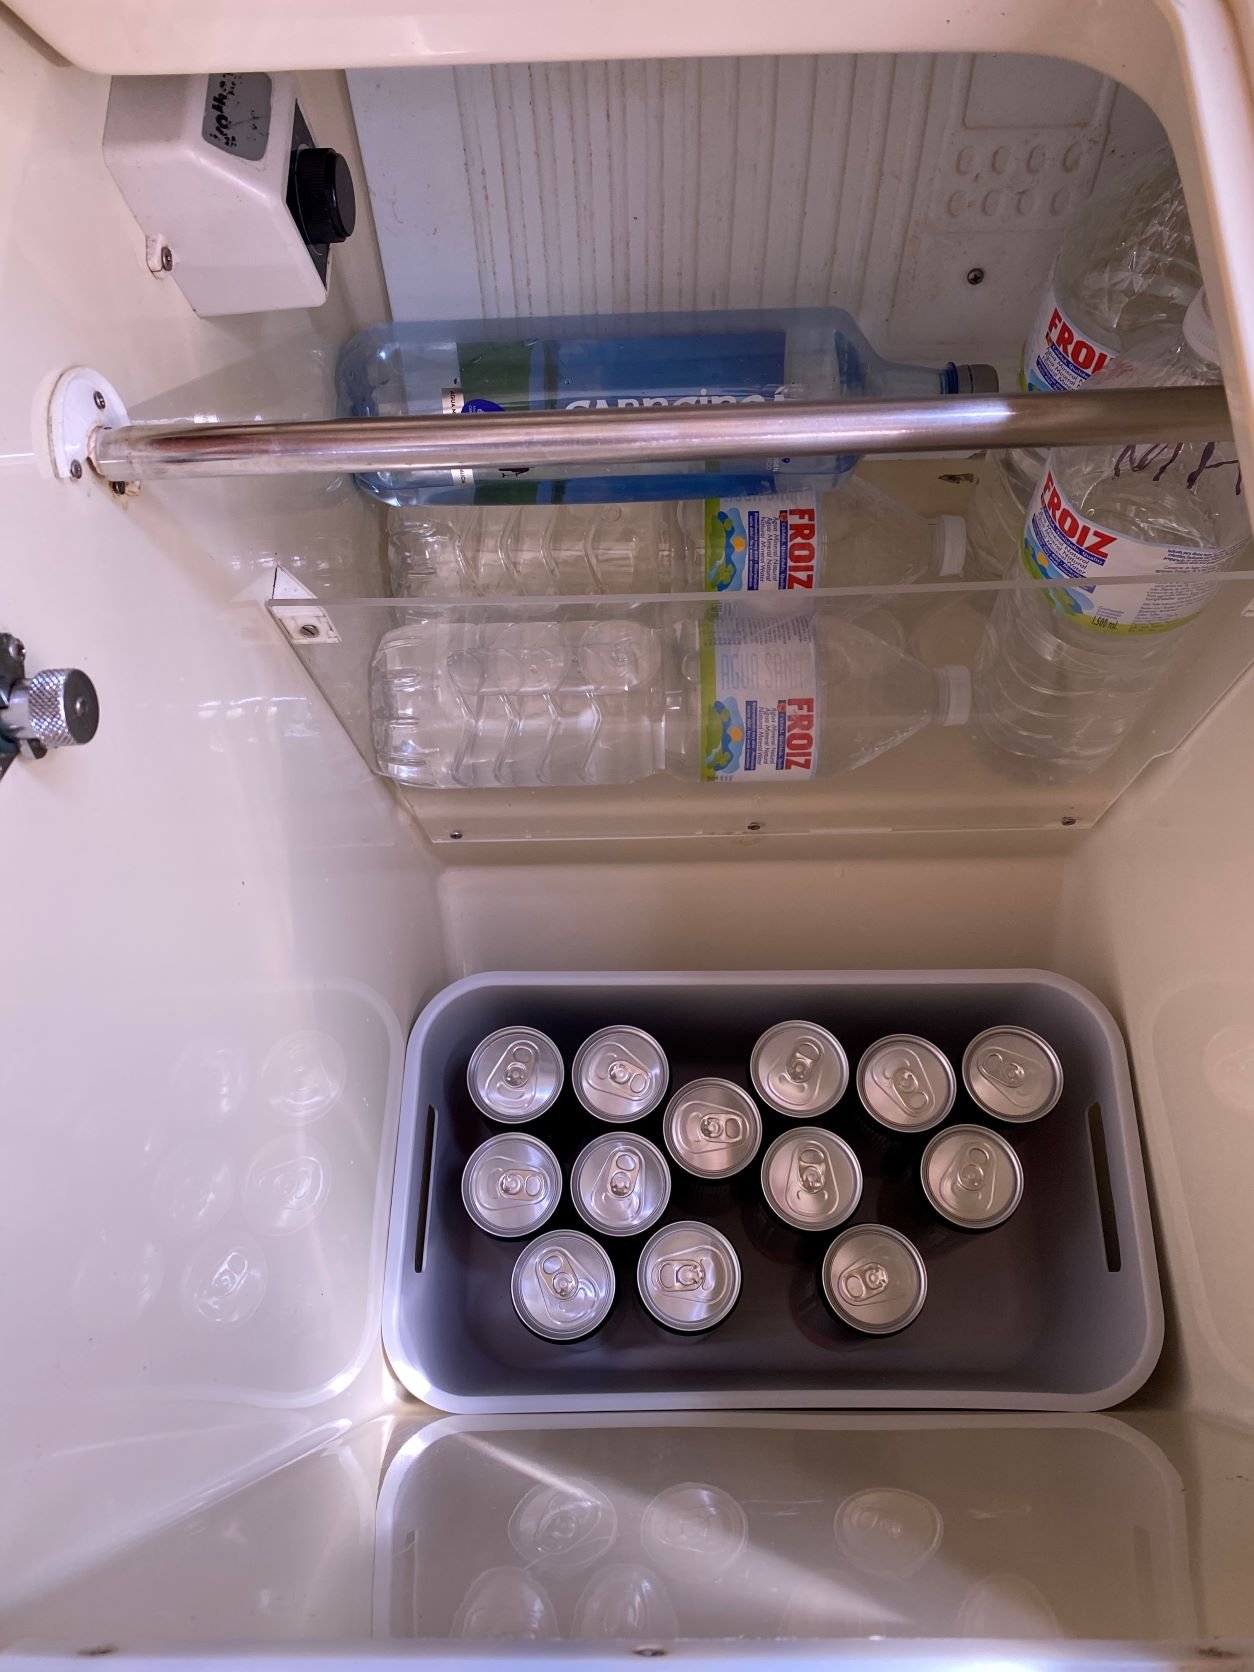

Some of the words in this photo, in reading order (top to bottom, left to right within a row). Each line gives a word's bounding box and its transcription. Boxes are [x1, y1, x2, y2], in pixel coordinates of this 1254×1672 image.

[1046, 307, 1108, 374] FROI
[1043, 470, 1117, 559] FROIZ
[787, 509, 816, 590] FROIZ
[1062, 551, 1087, 570] Natural
[1064, 546, 1089, 565] Natural
[1066, 560, 1085, 575] Water
[1082, 550, 1104, 567] Quality
[785, 698, 814, 770] FROIZ
